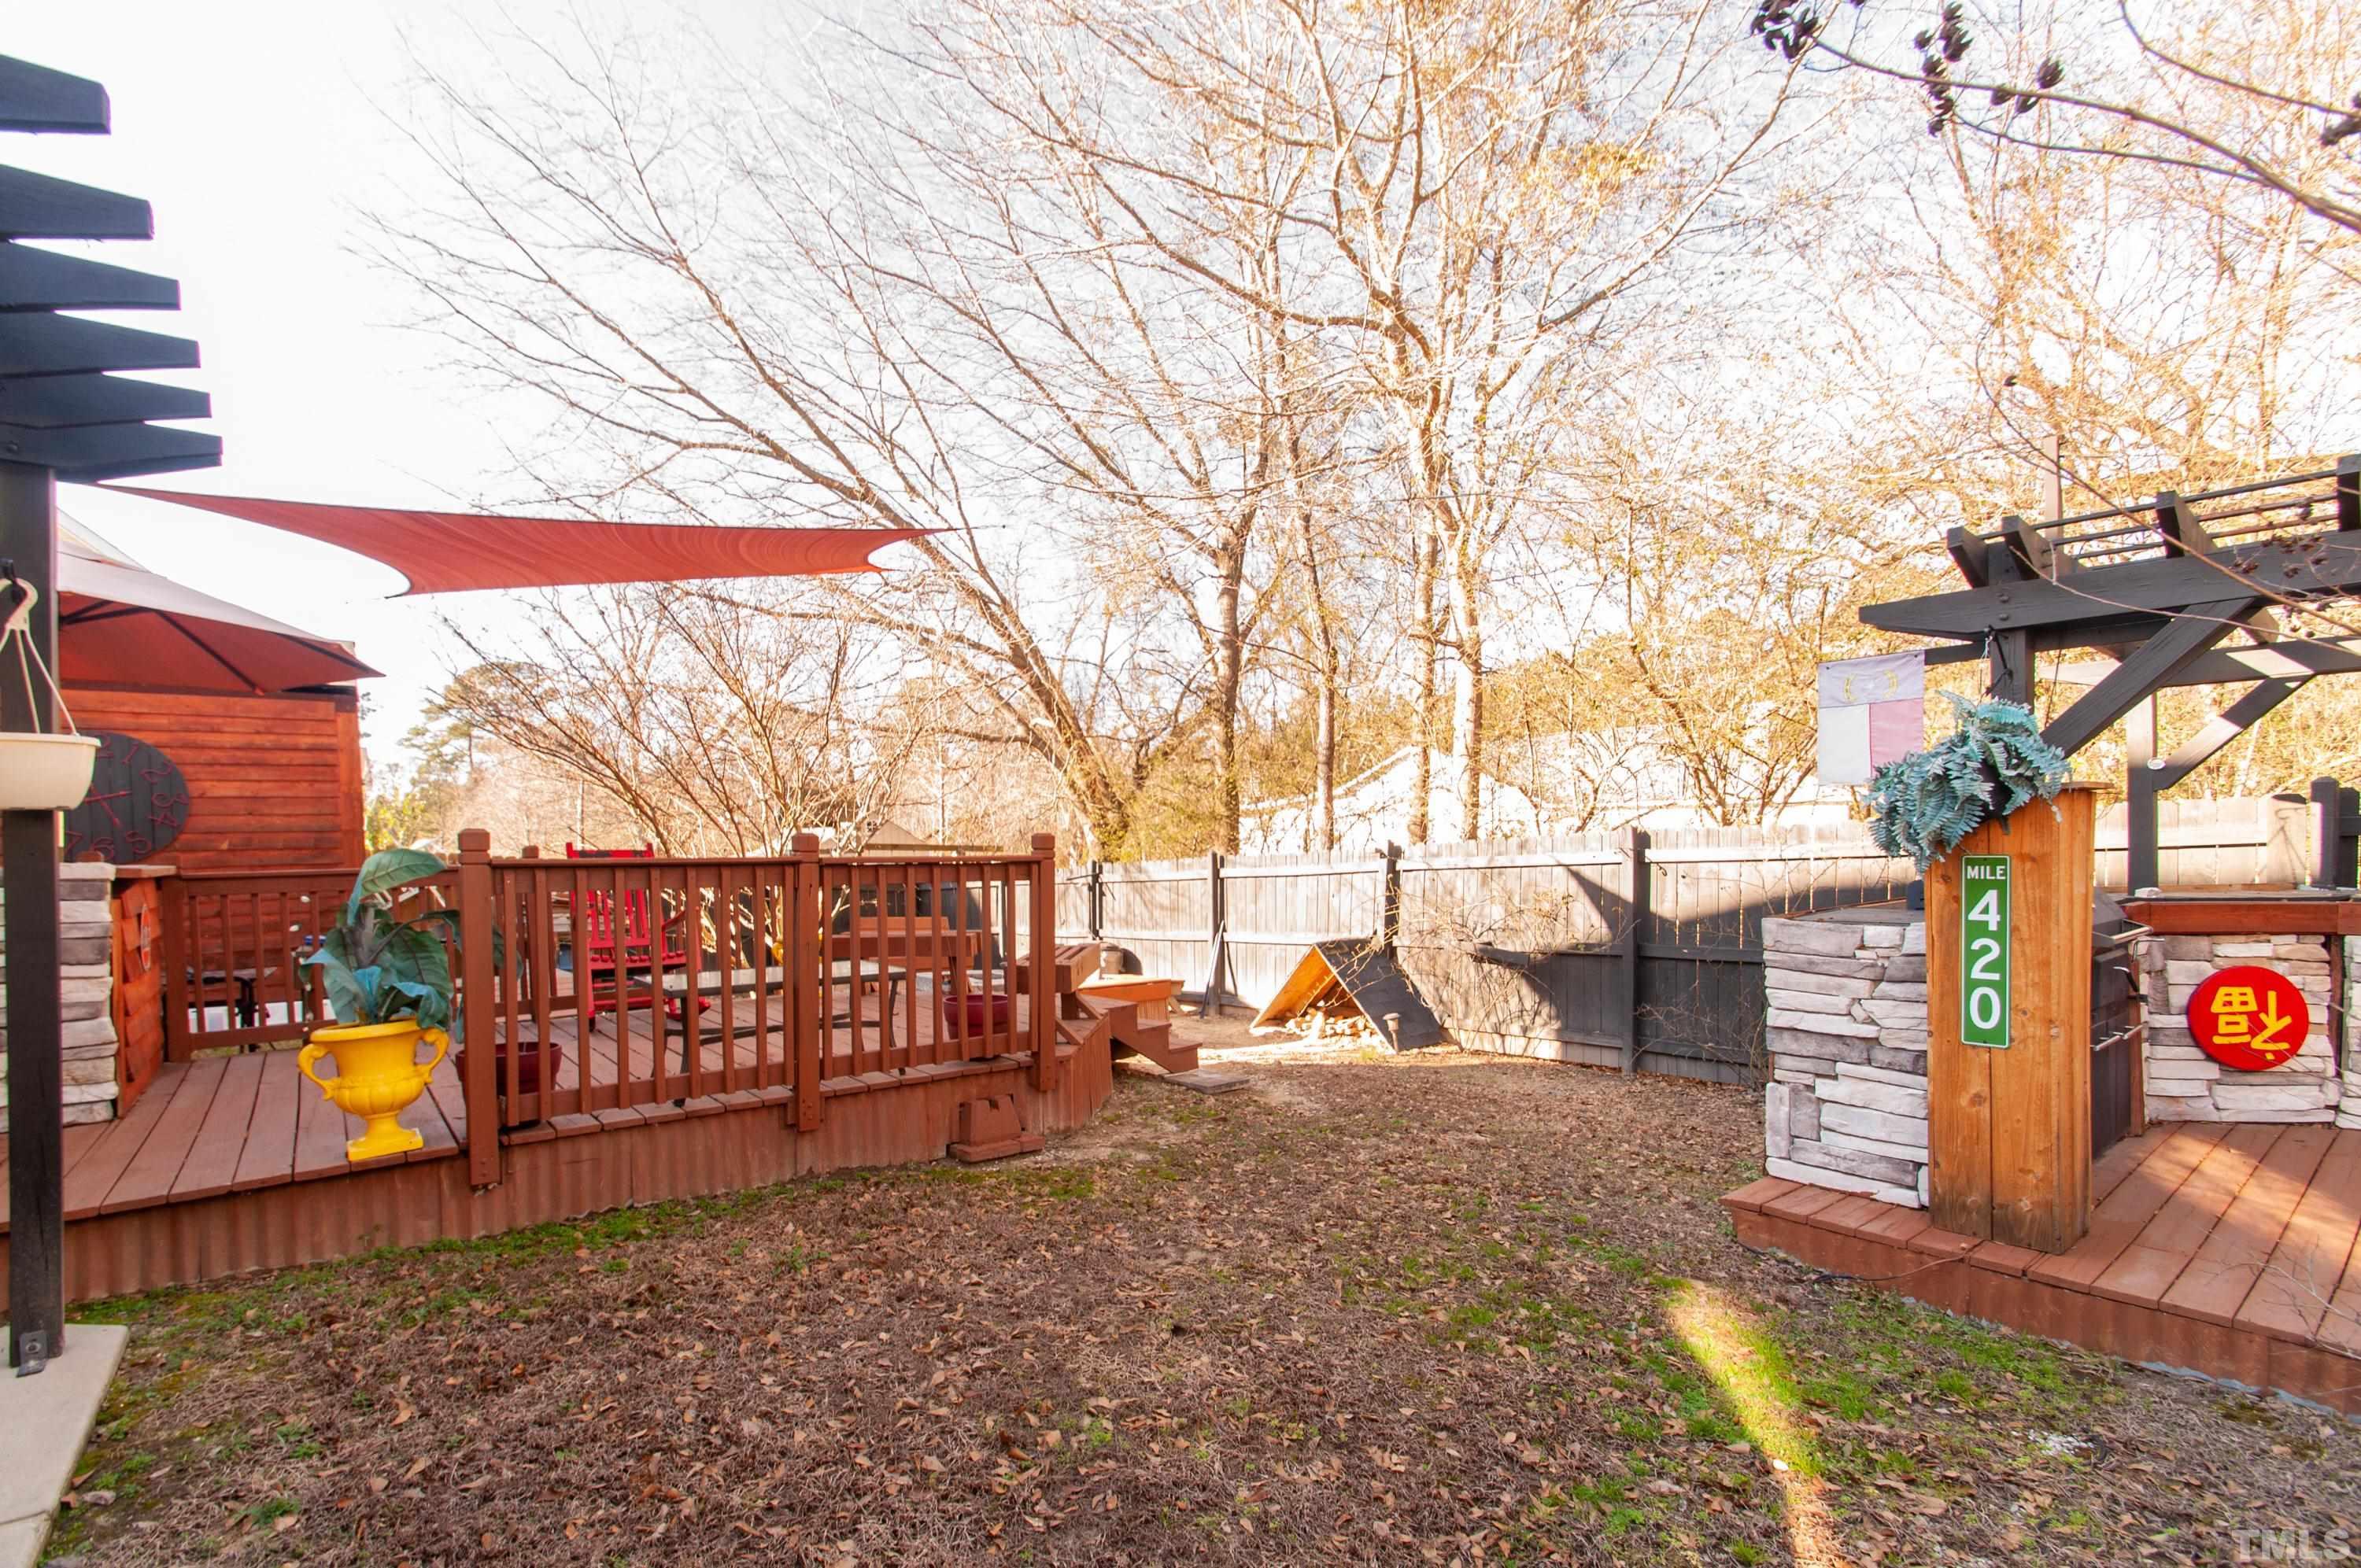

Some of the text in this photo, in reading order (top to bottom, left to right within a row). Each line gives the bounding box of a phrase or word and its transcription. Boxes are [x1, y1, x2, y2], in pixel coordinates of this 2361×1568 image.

[139, 758, 176, 785] 2
[151, 792, 190, 808] 3
[146, 811, 178, 828] 4
[126, 830, 152, 854] 5
[1967, 865, 2006, 880] MILE
[1968, 889, 2001, 1029] 420
[2210, 986, 2292, 1060] 福
